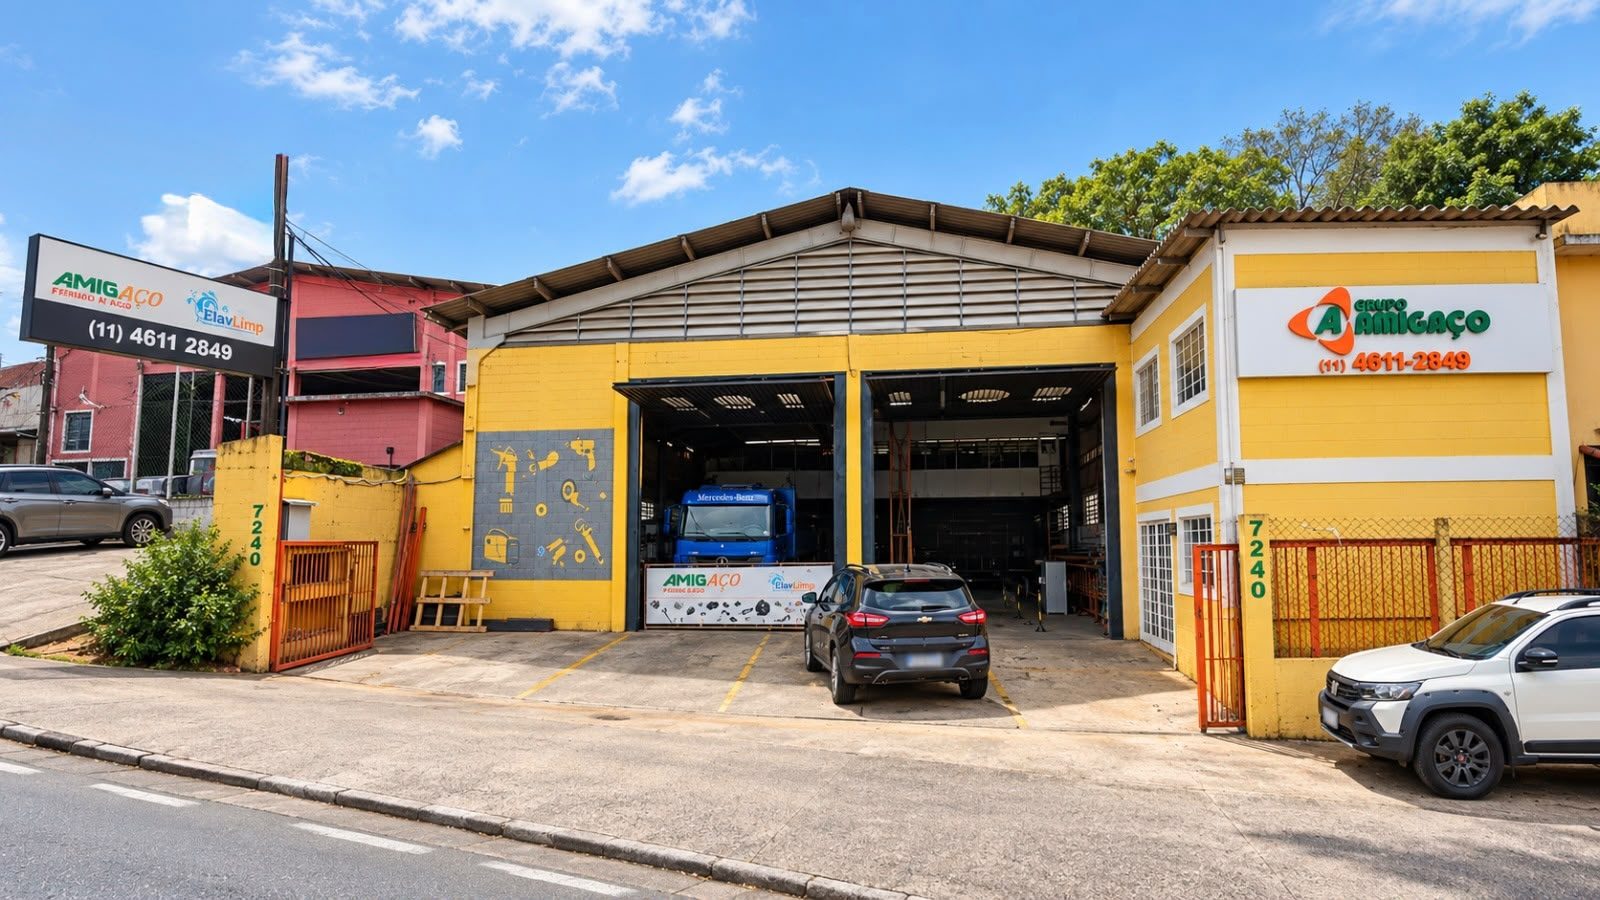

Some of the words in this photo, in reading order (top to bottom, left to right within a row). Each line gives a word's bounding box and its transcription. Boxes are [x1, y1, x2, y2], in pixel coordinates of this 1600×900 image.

[52, 271, 164, 309] AMIGAÇO
[1353, 298, 1408, 312] GRUPO
[203, 308, 264, 336] ElavLimp
[1354, 309, 1491, 340] AMIGAÇO
[88, 319, 123, 343] (11)
[129, 327, 177, 350] 4611
[184, 337, 233, 360] 2849
[1318, 359, 1347, 374] (11)
[1351, 350, 1471, 372] 4611-2849
[249, 504, 265, 567] 7240
[1249, 519, 1266, 598] 7240
[663, 573, 741, 592] AMIGAÇO
